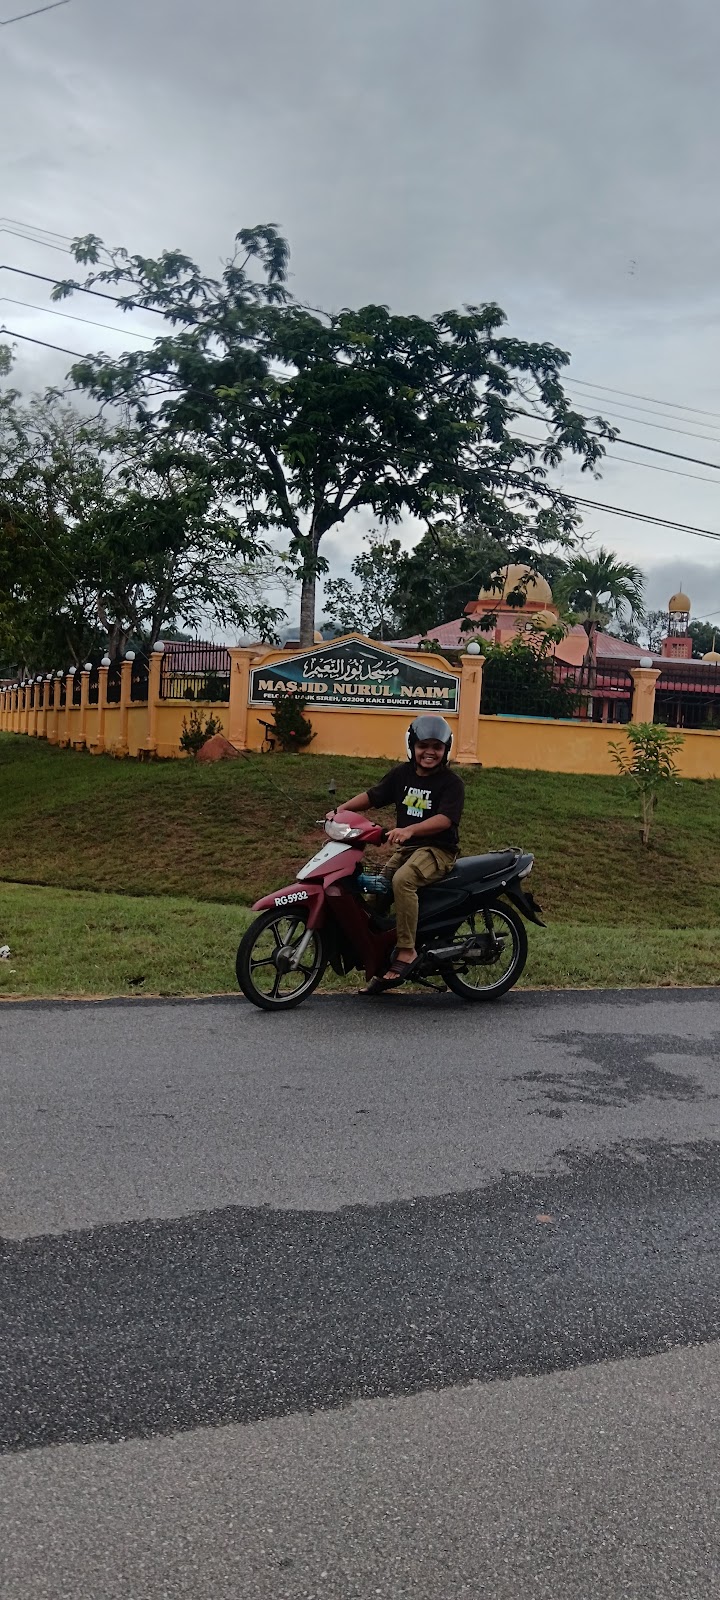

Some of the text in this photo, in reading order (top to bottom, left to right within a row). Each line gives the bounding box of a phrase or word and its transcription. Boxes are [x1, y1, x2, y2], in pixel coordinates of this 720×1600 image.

[258, 680, 449, 698] MASJID NURUL NAIM
